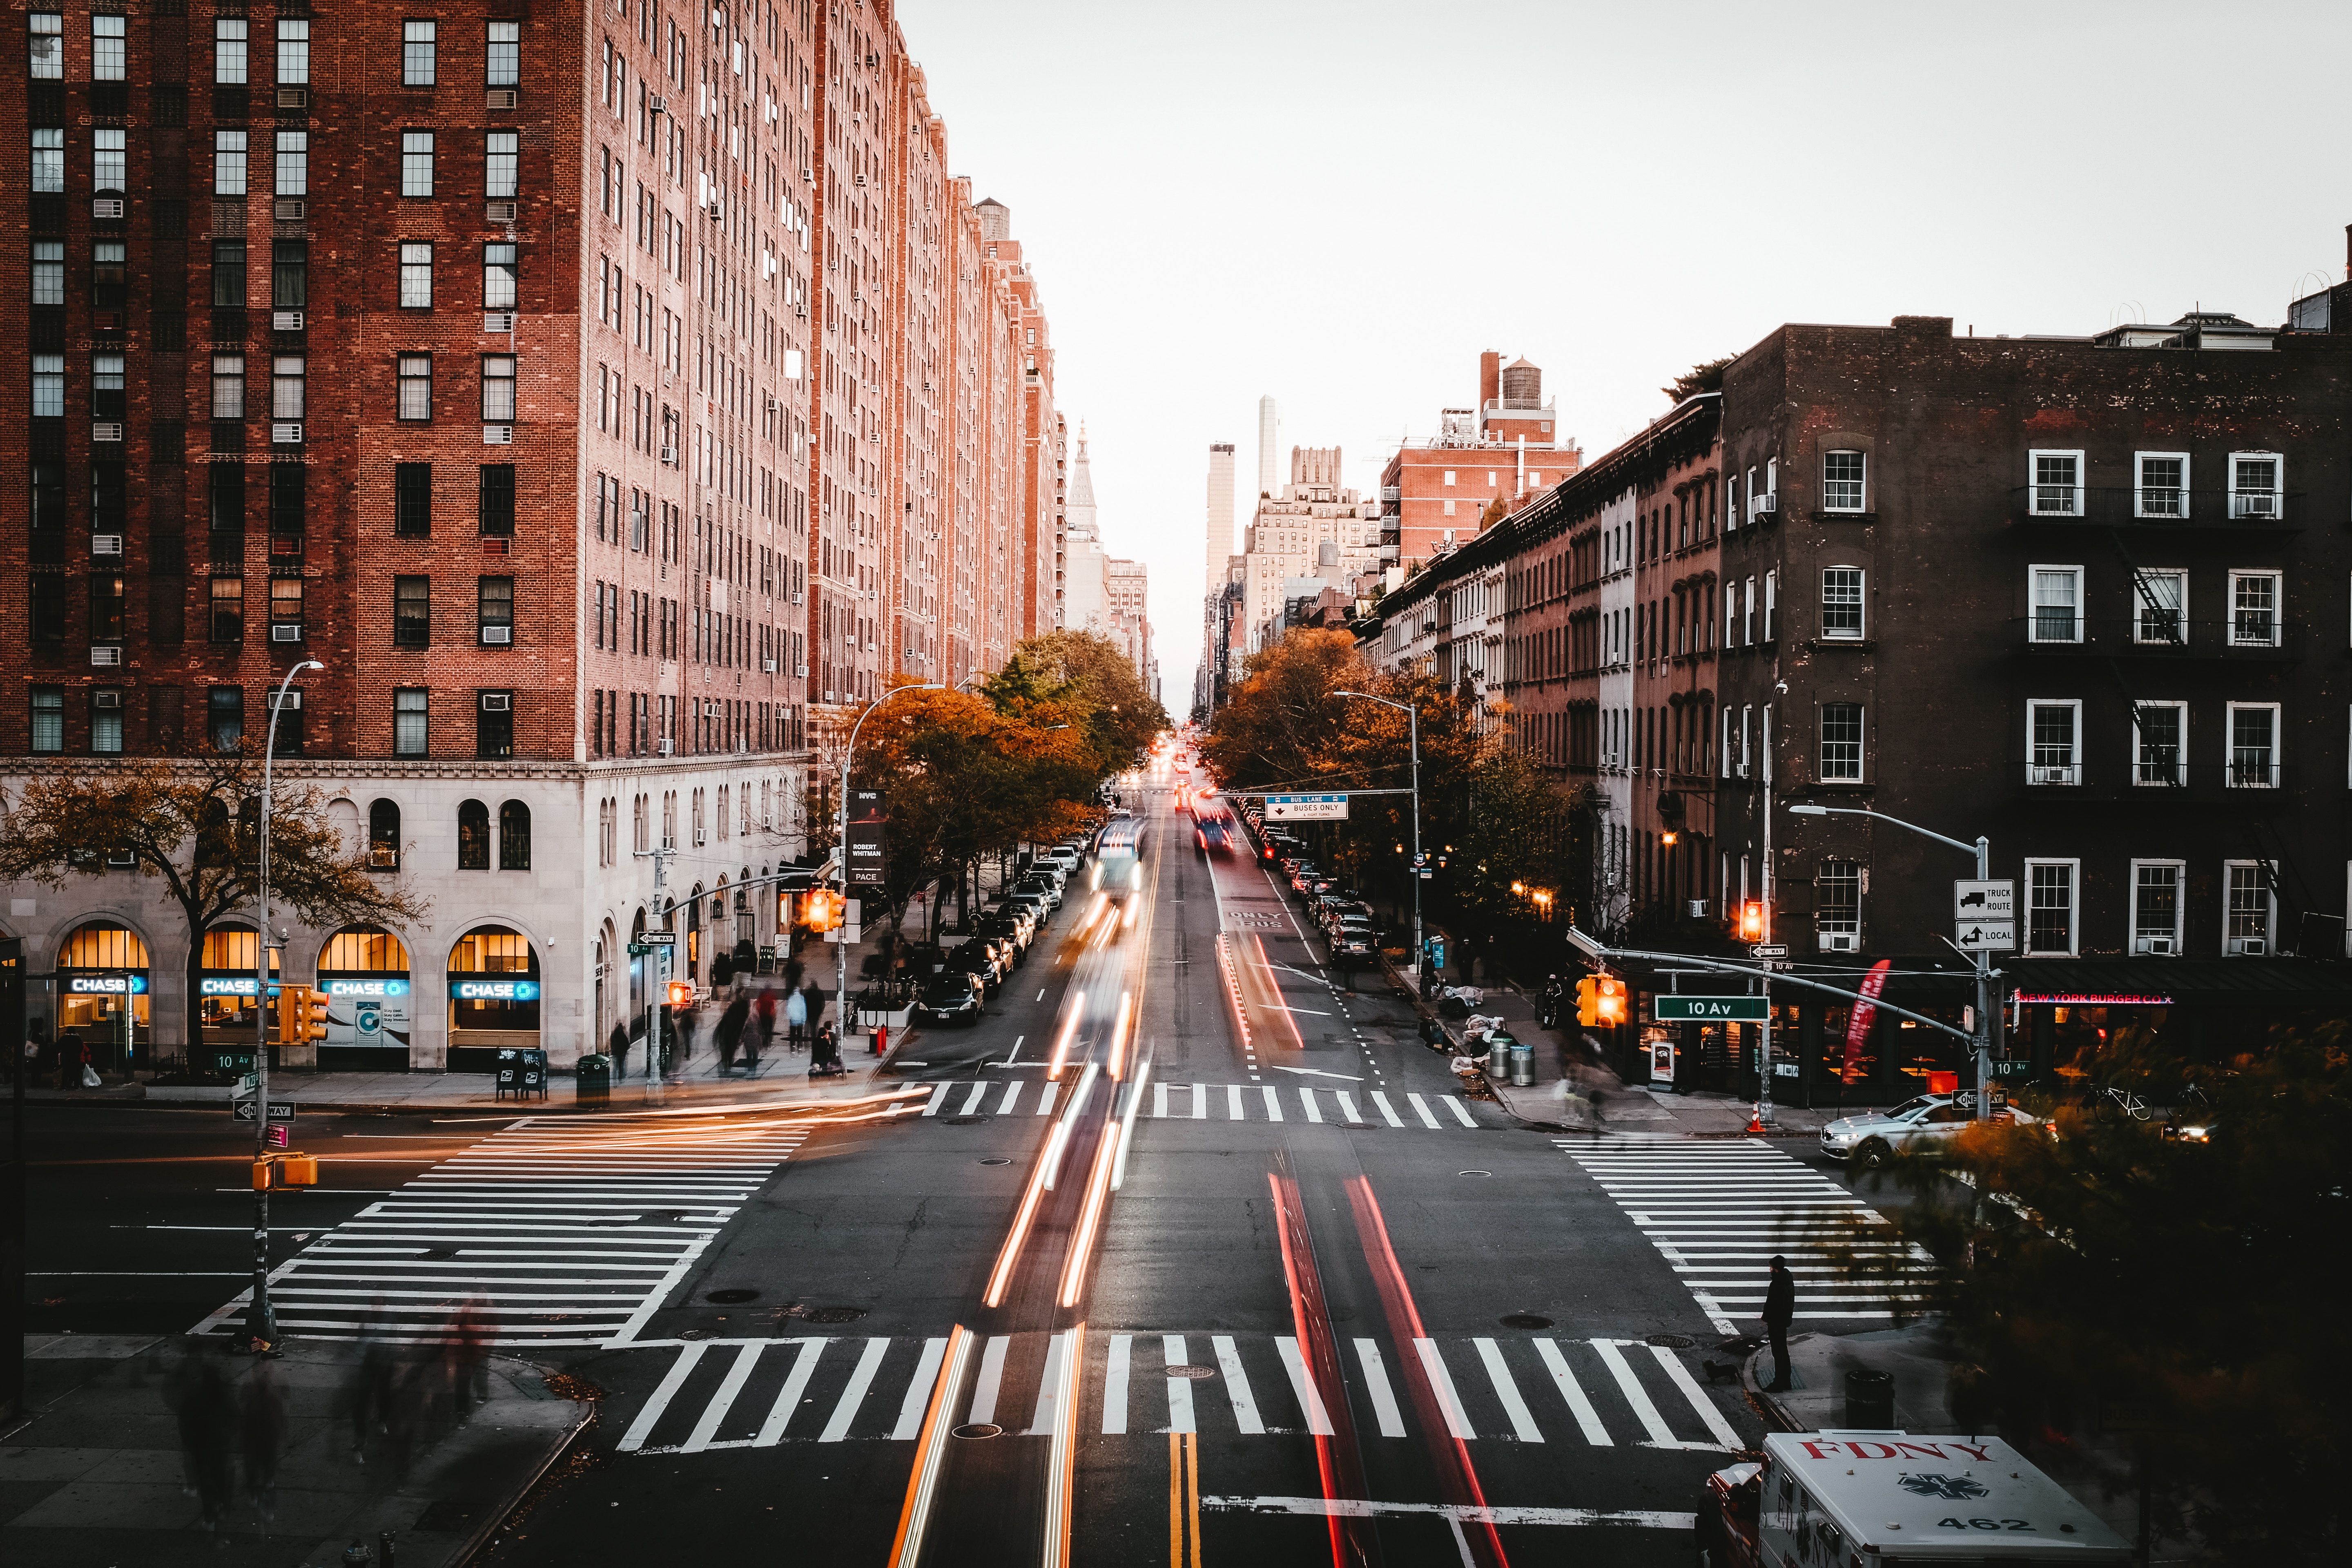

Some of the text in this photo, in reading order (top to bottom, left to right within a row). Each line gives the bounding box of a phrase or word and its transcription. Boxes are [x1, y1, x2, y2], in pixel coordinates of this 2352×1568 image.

[203, 981, 255, 993] CHASE
[332, 983, 385, 995] CHASE
[462, 984, 514, 996] CHASE
[2020, 993, 2049, 1002] NEW
[2053, 994, 2087, 1003] YORK
[2090, 994, 2140, 1003] BURGER
[2142, 995, 2161, 1004] CO
[1688, 1002, 1705, 1015] 10
[219, 1056, 232, 1067] 10
[1998, 1063, 2010, 1074] 10
[246, 1076, 250, 1088] W
[250, 1075, 255, 1086] 23
[243, 1106, 255, 1115] ON
[1799, 1441, 1995, 1461] FDNY
[1937, 1517, 2037, 1531] 462
